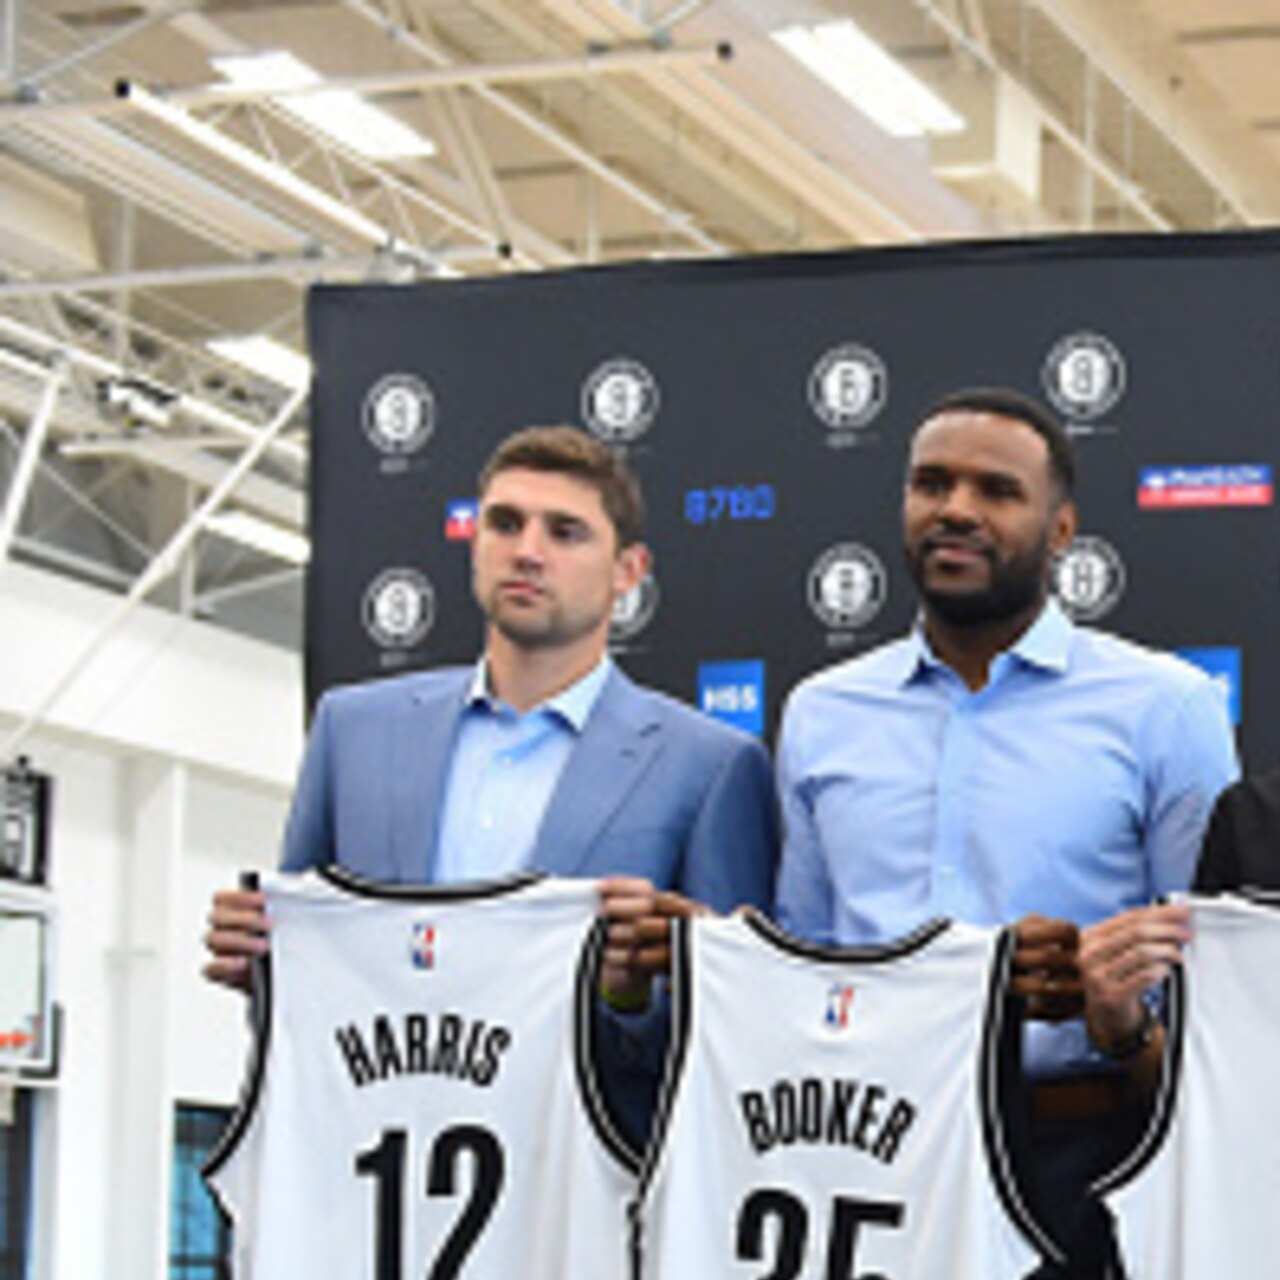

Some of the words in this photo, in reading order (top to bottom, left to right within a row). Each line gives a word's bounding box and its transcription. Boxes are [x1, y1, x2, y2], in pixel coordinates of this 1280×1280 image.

[704, 684, 758, 711] HSS
[335, 1013, 512, 1088] HARRIS
[739, 1078, 917, 1165] BOOKER
